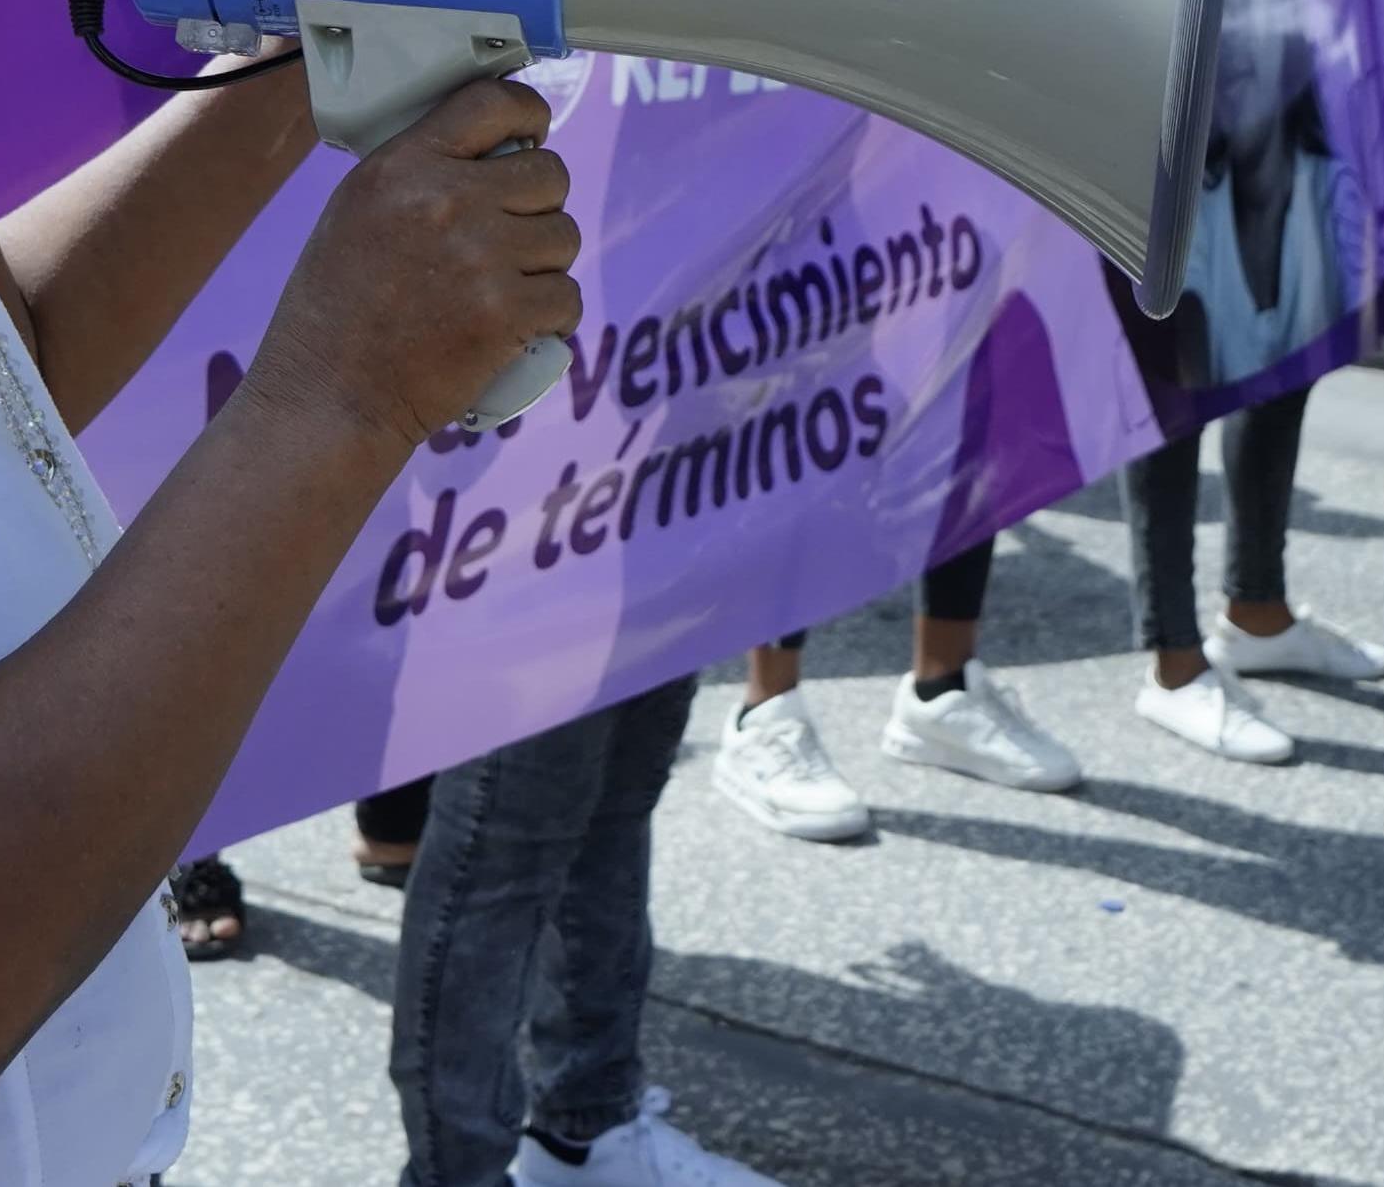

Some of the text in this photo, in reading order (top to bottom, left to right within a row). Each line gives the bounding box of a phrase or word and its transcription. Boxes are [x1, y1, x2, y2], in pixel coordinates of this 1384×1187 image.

[566, 203, 983, 423] vencimiento
[373, 371, 888, 627] de términos
